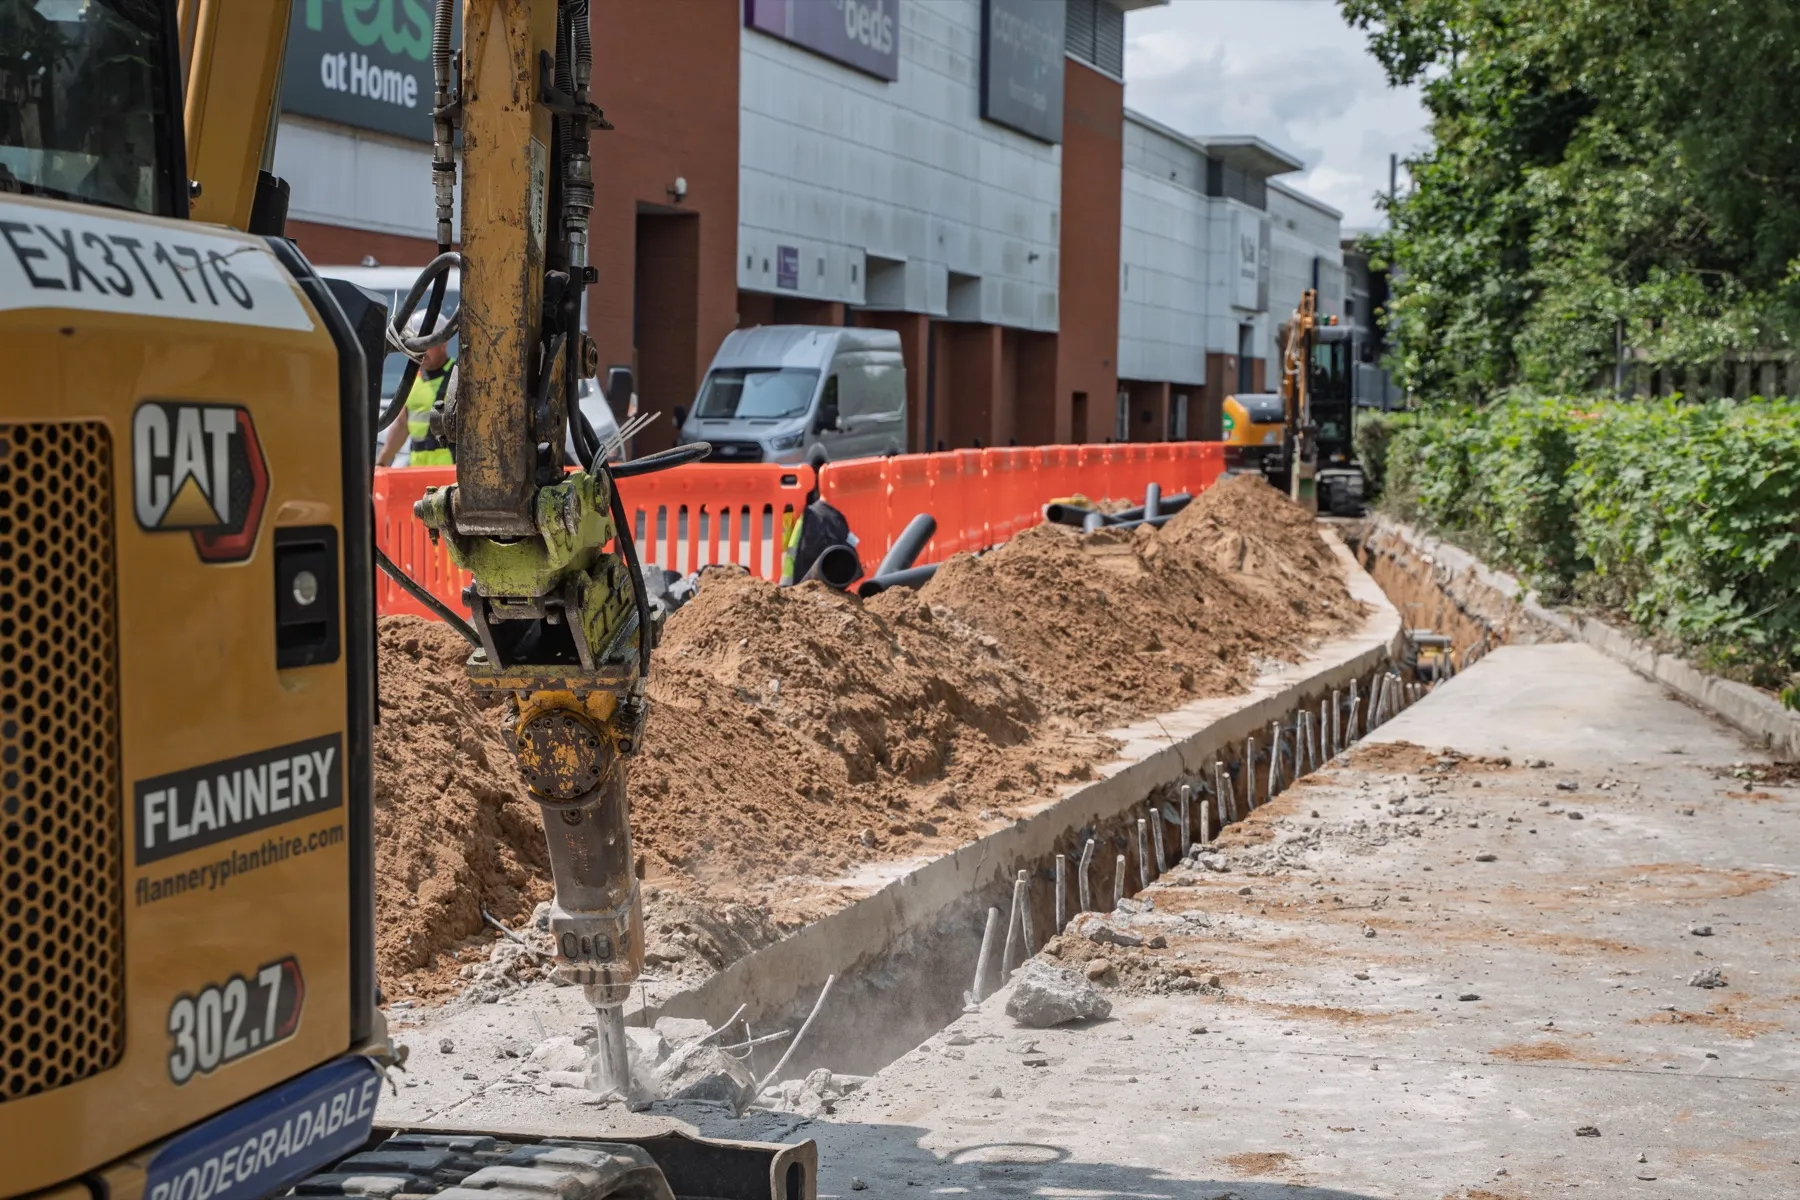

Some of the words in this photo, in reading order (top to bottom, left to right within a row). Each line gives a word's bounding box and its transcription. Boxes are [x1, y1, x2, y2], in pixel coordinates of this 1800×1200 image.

[321, 53, 347, 92] at
[350, 52, 418, 108] Home
[0, 221, 254, 310] EX3T176
[134, 403, 237, 527] CAT
[144, 747, 335, 848] FLANNERY
[135, 825, 343, 907] flanneryplanthire.com
[170, 964, 282, 1081] 302.7
